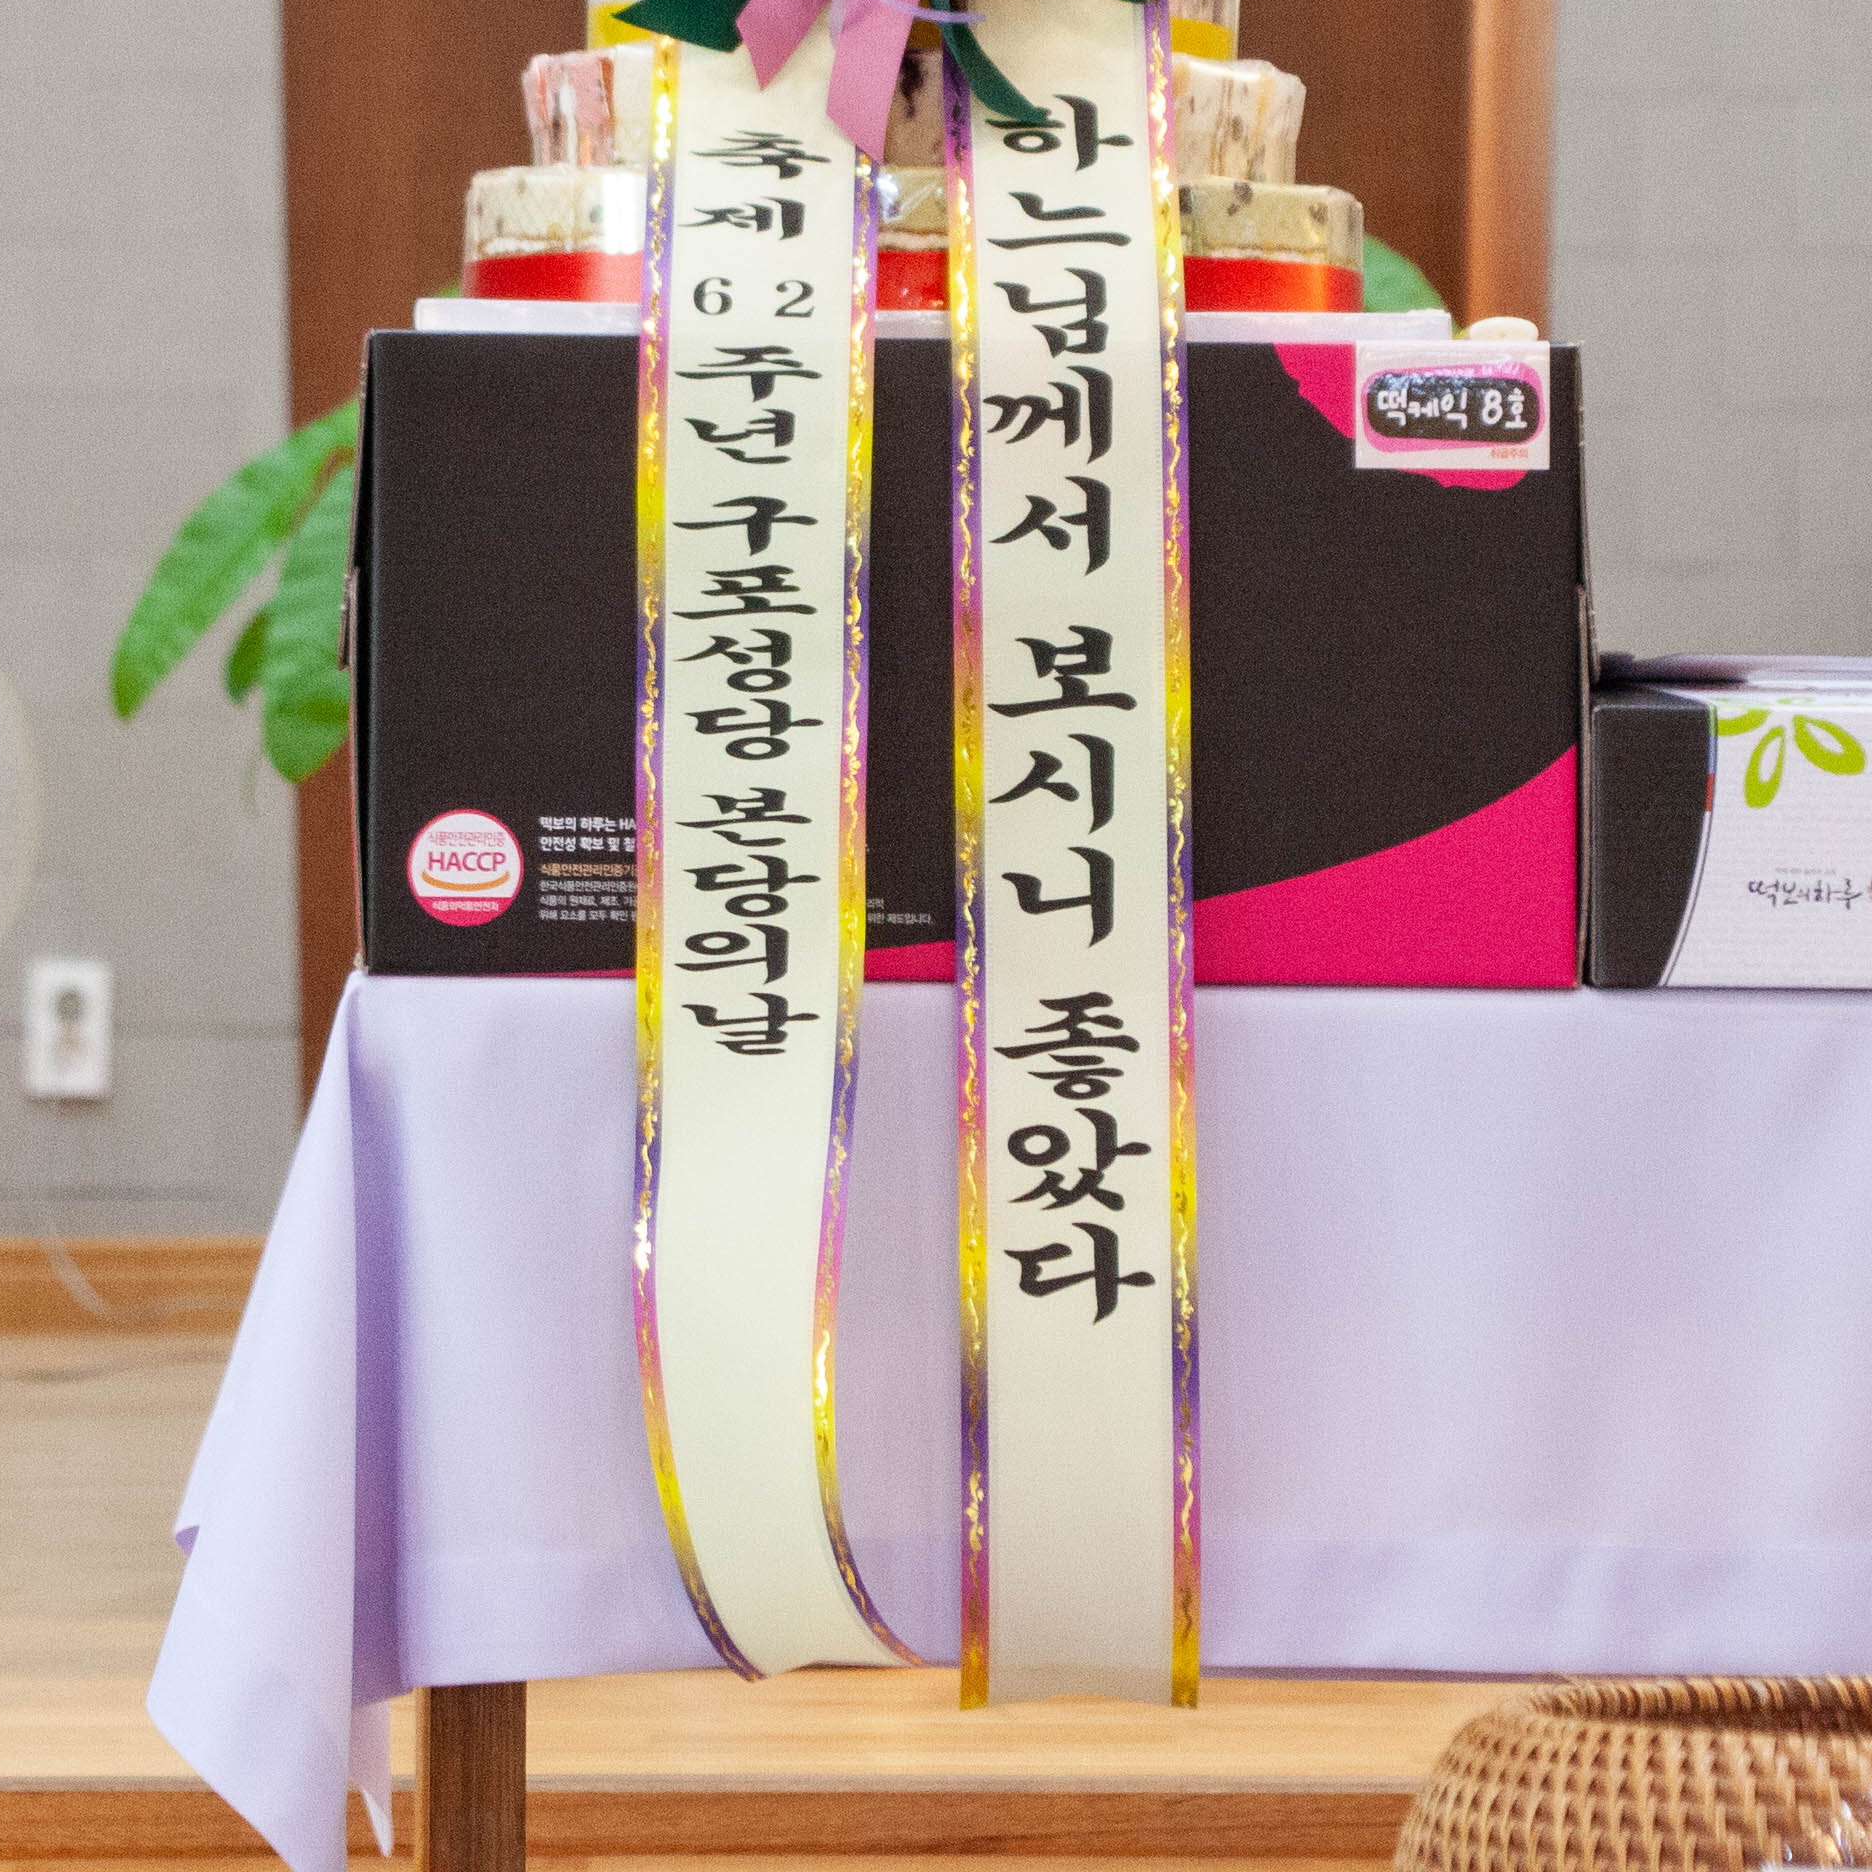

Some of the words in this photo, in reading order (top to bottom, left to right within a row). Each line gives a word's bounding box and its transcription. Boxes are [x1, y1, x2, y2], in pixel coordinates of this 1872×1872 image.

[983, 92, 1135, 577] 하느님께서
[1377, 386, 1468, 431] 떡케익
[1481, 387, 1528, 430] 8호
[672, 495, 825, 762] 구포성당
[985, 625, 1138, 948] 보시니
[539, 816, 577, 832] 떡보의
[579, 816, 617, 833] 하루는
[539, 836, 577, 852] 안전성
[579, 836, 604, 851] 확보
[607, 836, 621, 852] 및
[427, 851, 507, 872] HACCP
[540, 863, 636, 878] 식품안전관리인증기
[992, 990, 1156, 1325] 좋았다
